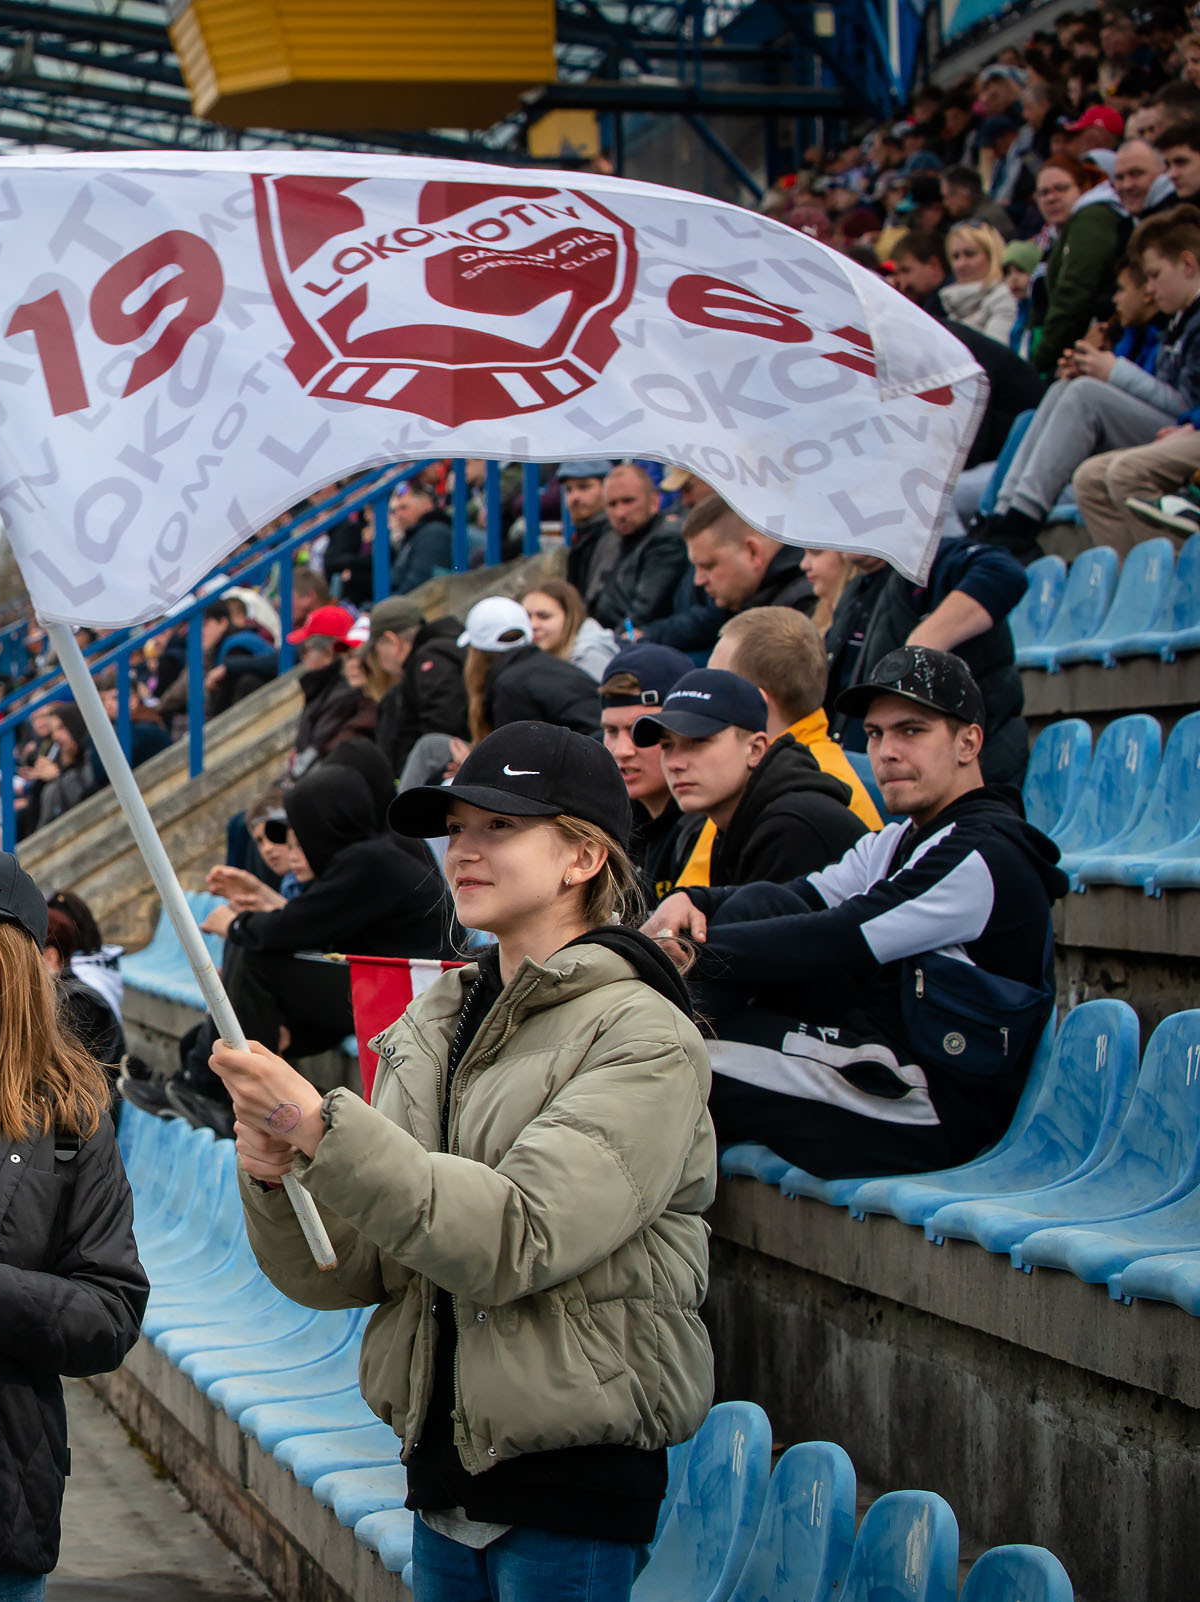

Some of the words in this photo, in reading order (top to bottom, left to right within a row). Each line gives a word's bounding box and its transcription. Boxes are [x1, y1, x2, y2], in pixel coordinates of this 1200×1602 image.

[457, 232, 615, 263] DAAVPILS
[559, 247, 612, 271] CLUB
[3, 229, 225, 418] 19
[650, 413, 929, 488] KOMOTIV
[1095, 1033, 1109, 1073] 18
[732, 1429, 745, 1478] 16
